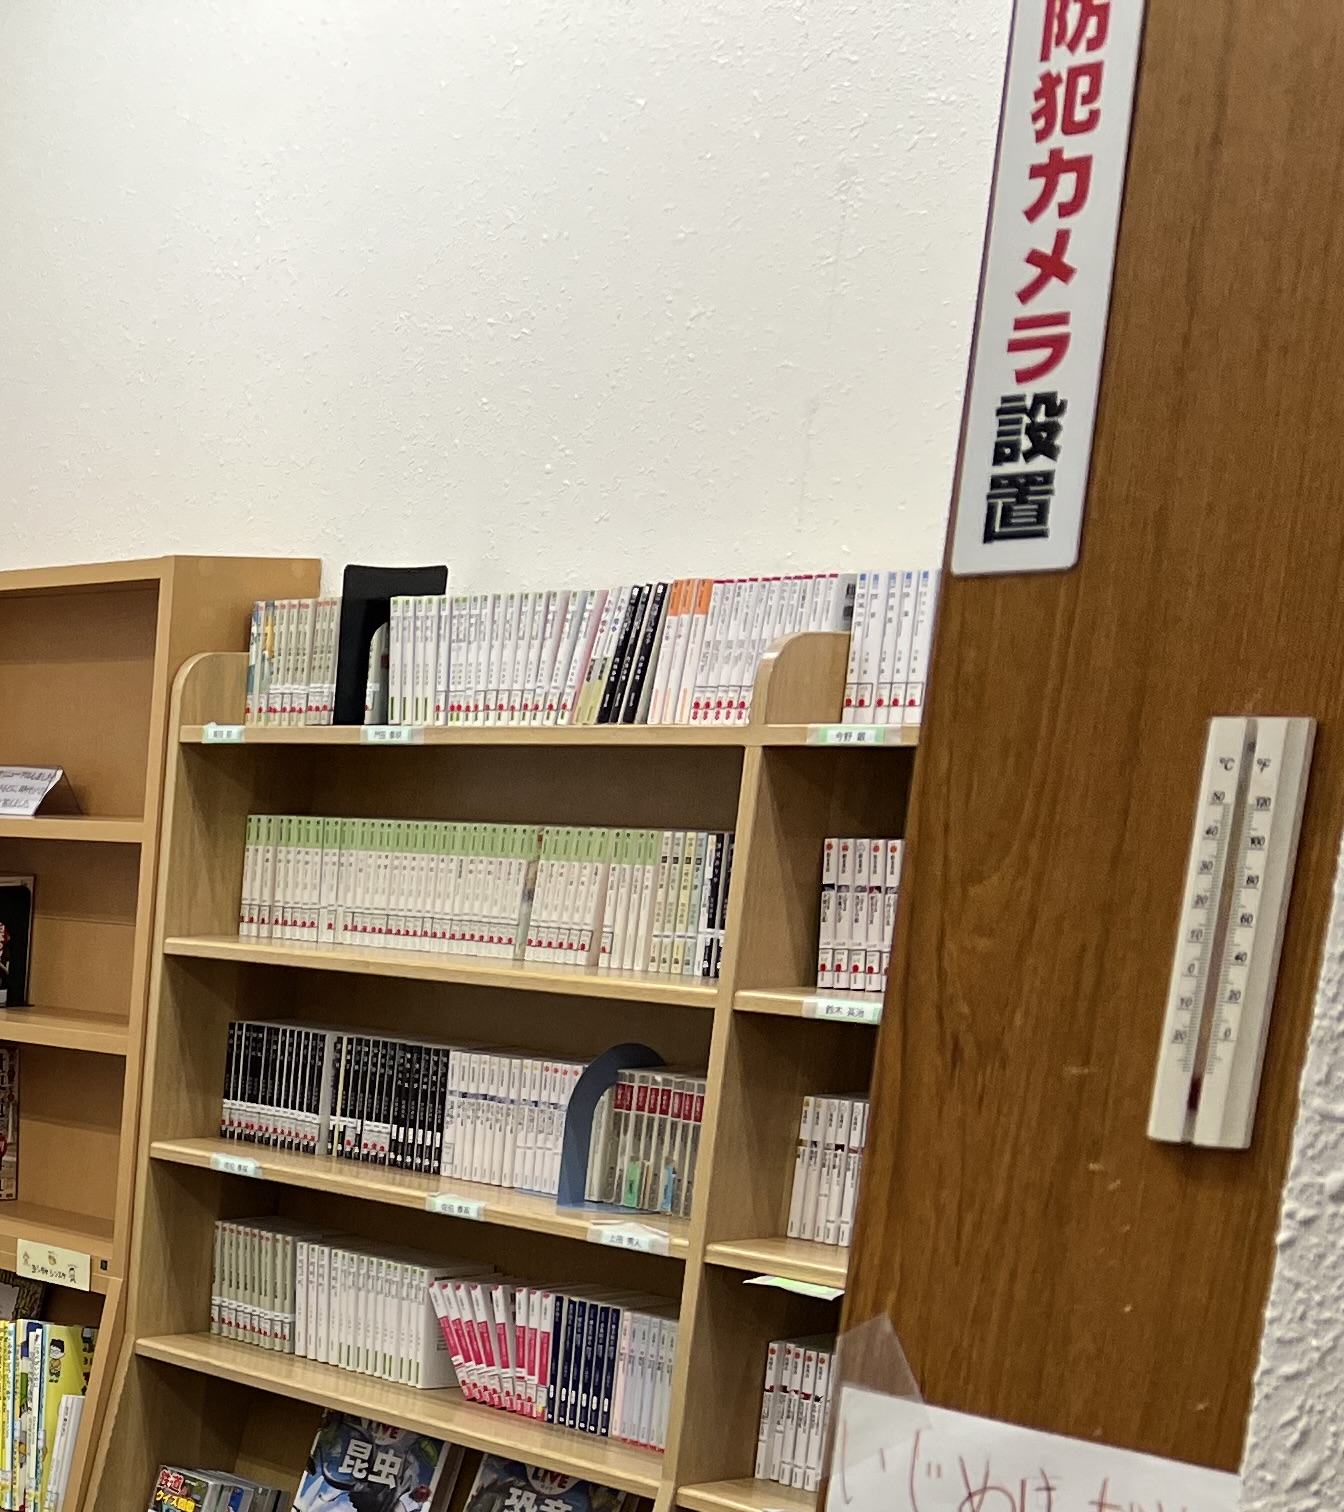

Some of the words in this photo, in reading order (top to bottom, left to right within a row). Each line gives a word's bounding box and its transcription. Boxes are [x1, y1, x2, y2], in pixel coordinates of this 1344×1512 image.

[982, 0, 1110, 544] 防犯カメラ設置
[835, 732, 852, 743] 今野
[1205, 825, 1219, 836] 40
[1250, 836, 1266, 847] 100
[1200, 860, 1213, 872] 30
[1246, 875, 1260, 886] 80
[1195, 895, 1209, 906] 20
[1240, 913, 1253, 925] 60
[1189, 929, 1203, 940] 10
[1234, 952, 1248, 963] 40
[1228, 990, 1242, 1001] 20
[1179, 997, 1192, 1008] 10
[825, 1005, 843, 1015] 鈴木
[338, 1438, 406, 1489] 昆虫
